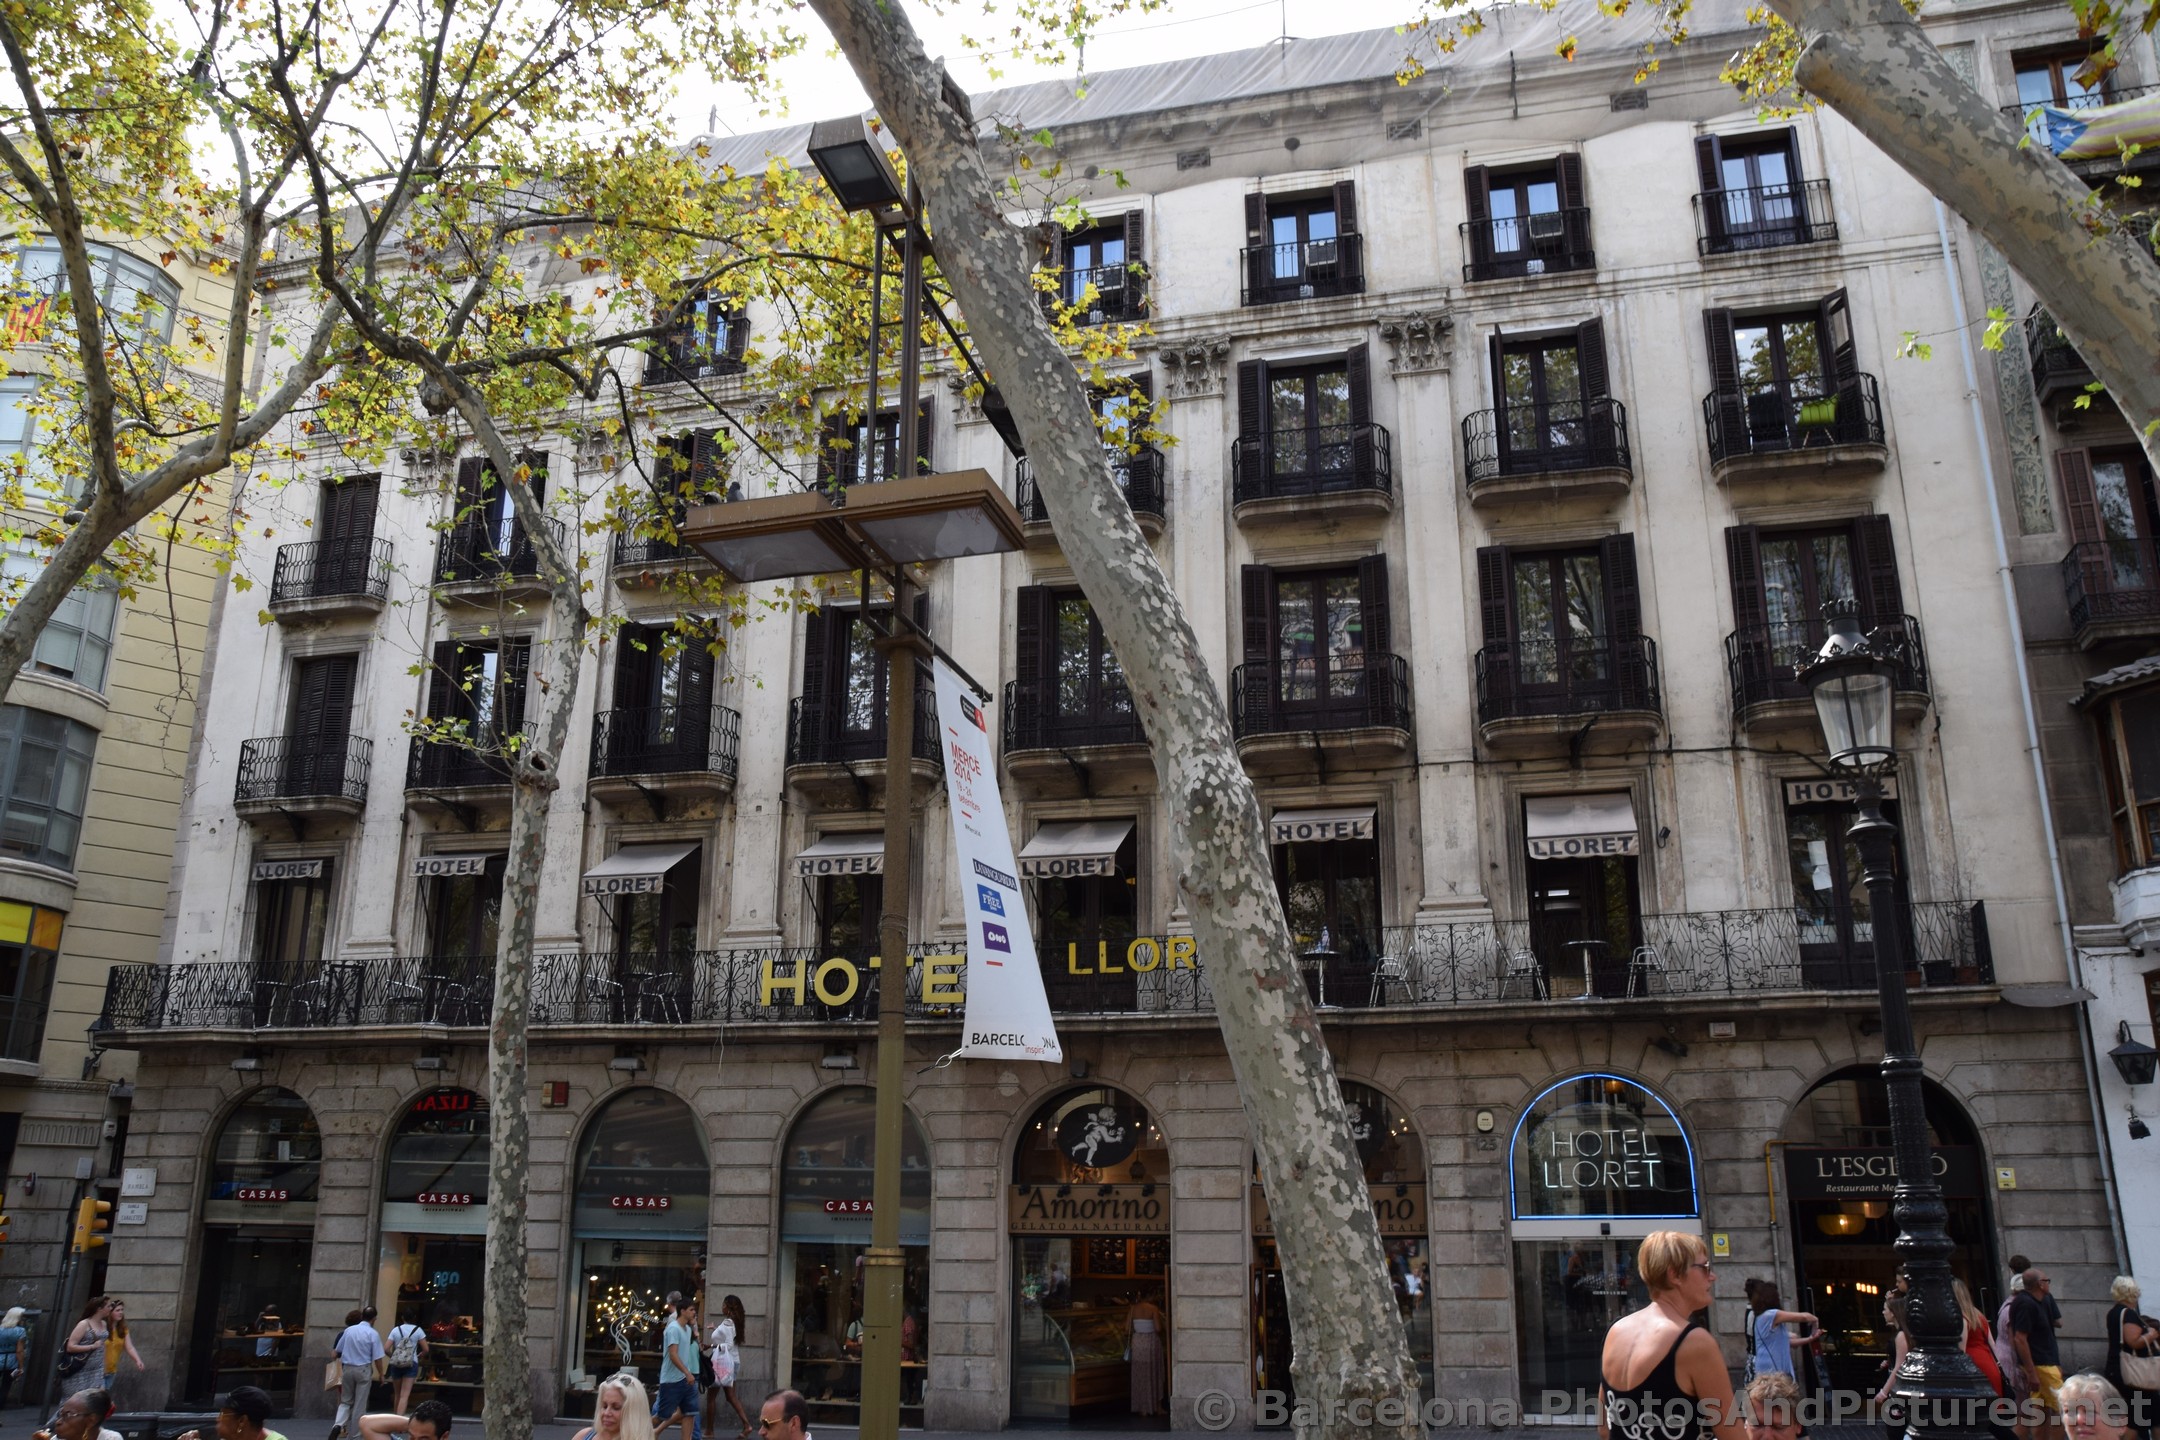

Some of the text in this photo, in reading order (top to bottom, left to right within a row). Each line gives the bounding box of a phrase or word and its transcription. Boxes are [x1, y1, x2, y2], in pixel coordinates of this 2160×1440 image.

[951, 741, 981, 776] MERCÈ
[953, 760, 972, 785] 2014
[1795, 783, 1890, 799] HOT
[1277, 821, 1365, 840] HOTEL
[1533, 836, 1633, 856] LLORET
[256, 862, 319, 878] LLORET
[415, 859, 479, 874] HOTEL
[800, 857, 878, 875] HOTEL
[1022, 857, 1111, 876] LLORET
[584, 876, 660, 894] LLORET
[761, 936, 1197, 1006] HOE LLOR
[1552, 1128, 1659, 1157] HOTEL
[1544, 1159, 1661, 1189] LLORET
[239, 1189, 287, 1199] CASAS
[1826, 1184, 1879, 1193] Restaurante
[418, 1193, 470, 1204] CASAS
[612, 1197, 668, 1207] CASAS
[826, 1201, 873, 1211] CASA
[1021, 1187, 1161, 1220] Amorino
[1011, 1222, 1170, 1232] GELATO AL NATURALE
